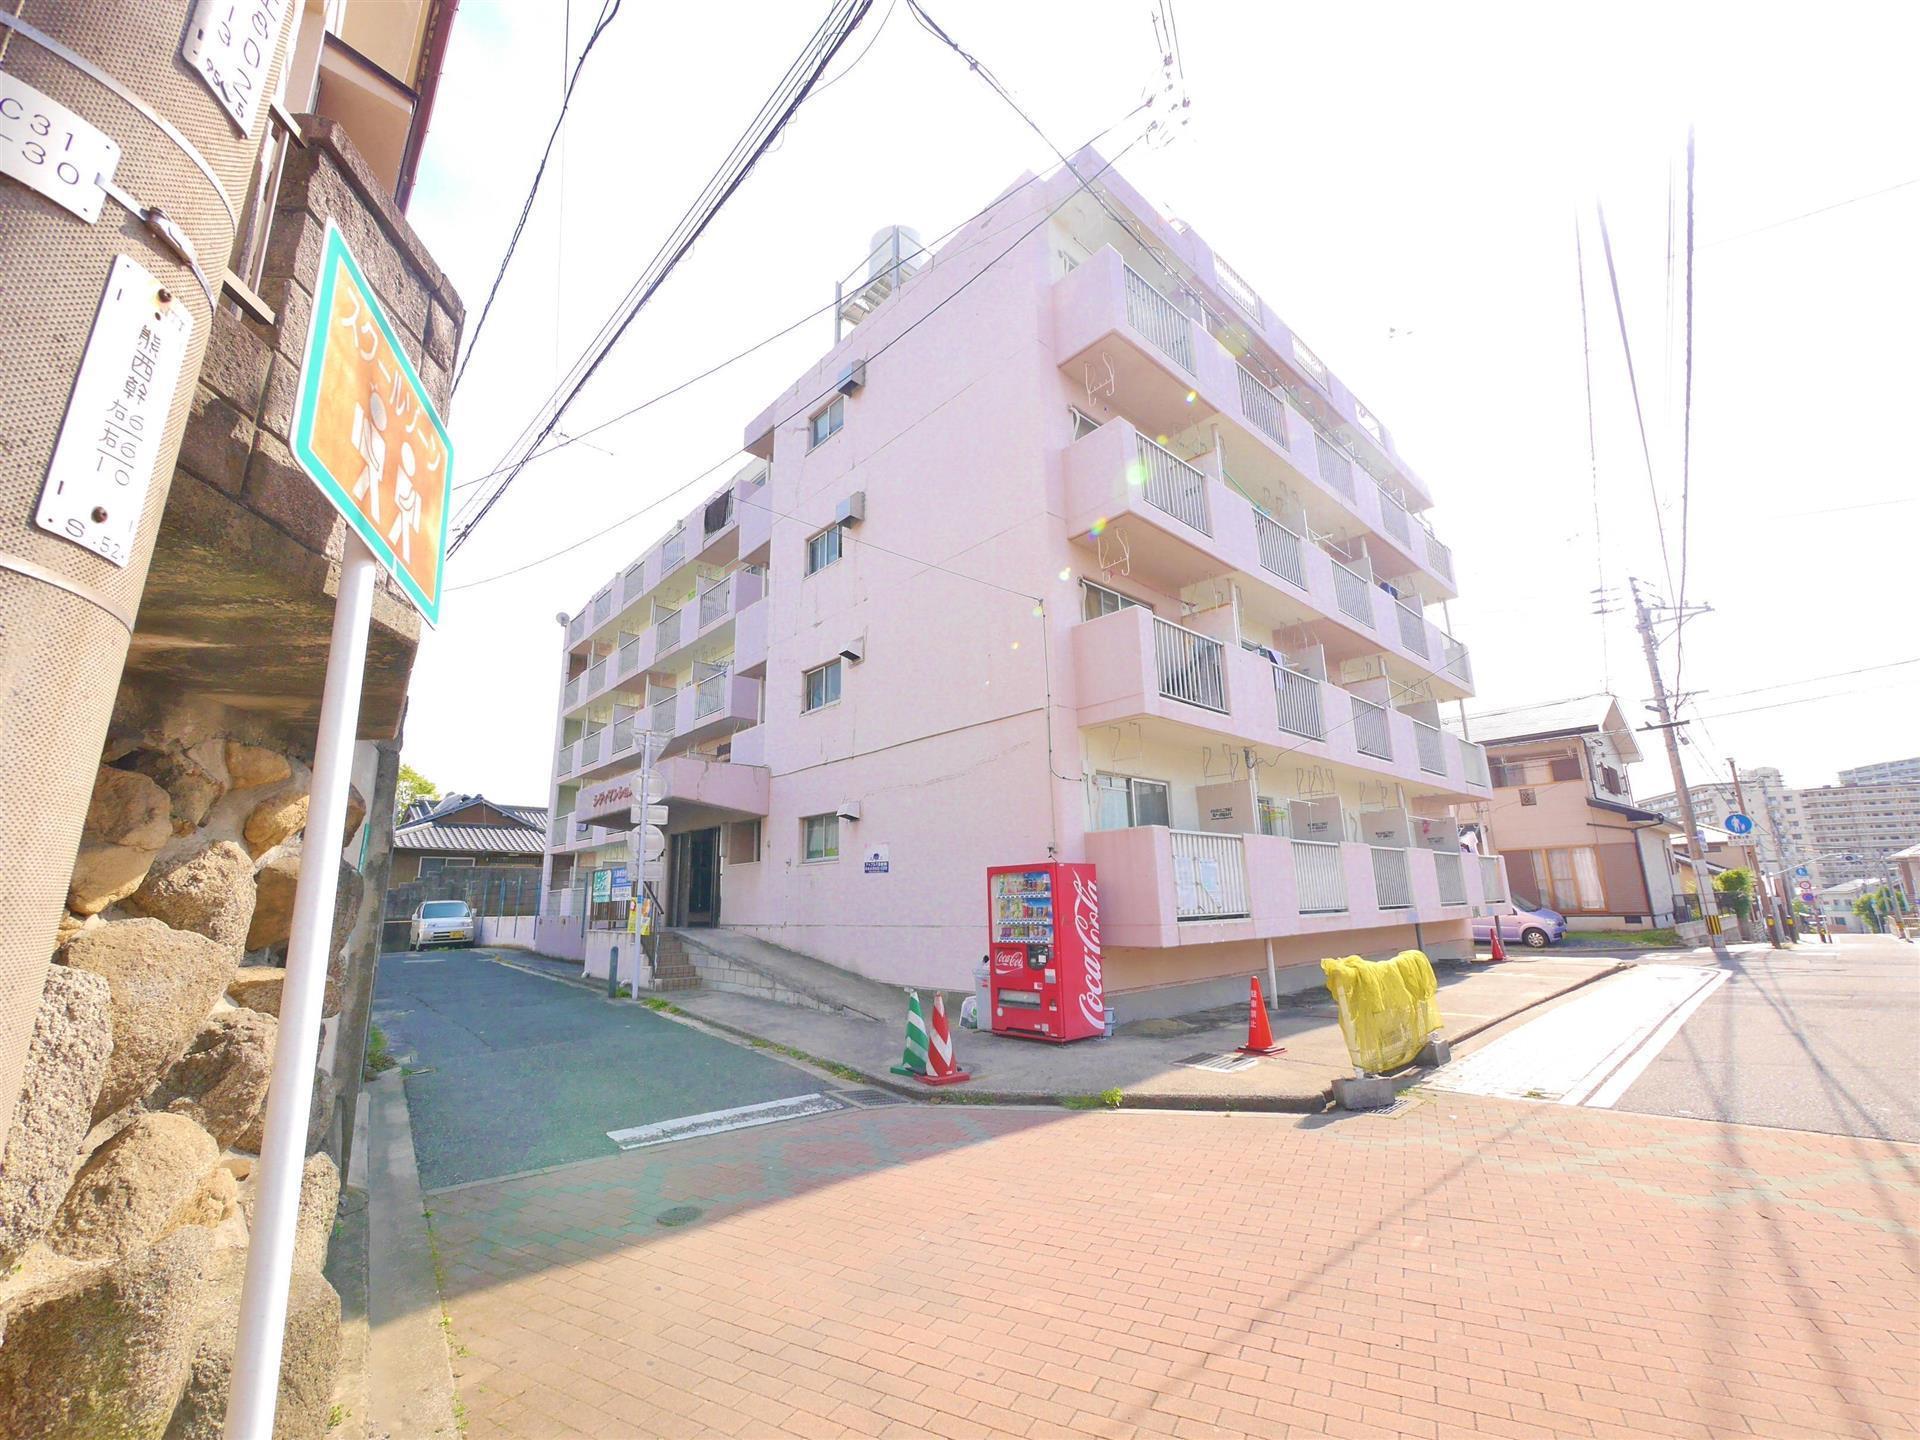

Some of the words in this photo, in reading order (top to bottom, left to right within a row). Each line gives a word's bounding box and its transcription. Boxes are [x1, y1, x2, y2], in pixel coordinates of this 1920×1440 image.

[340, 286, 441, 472] スクールゾーン
